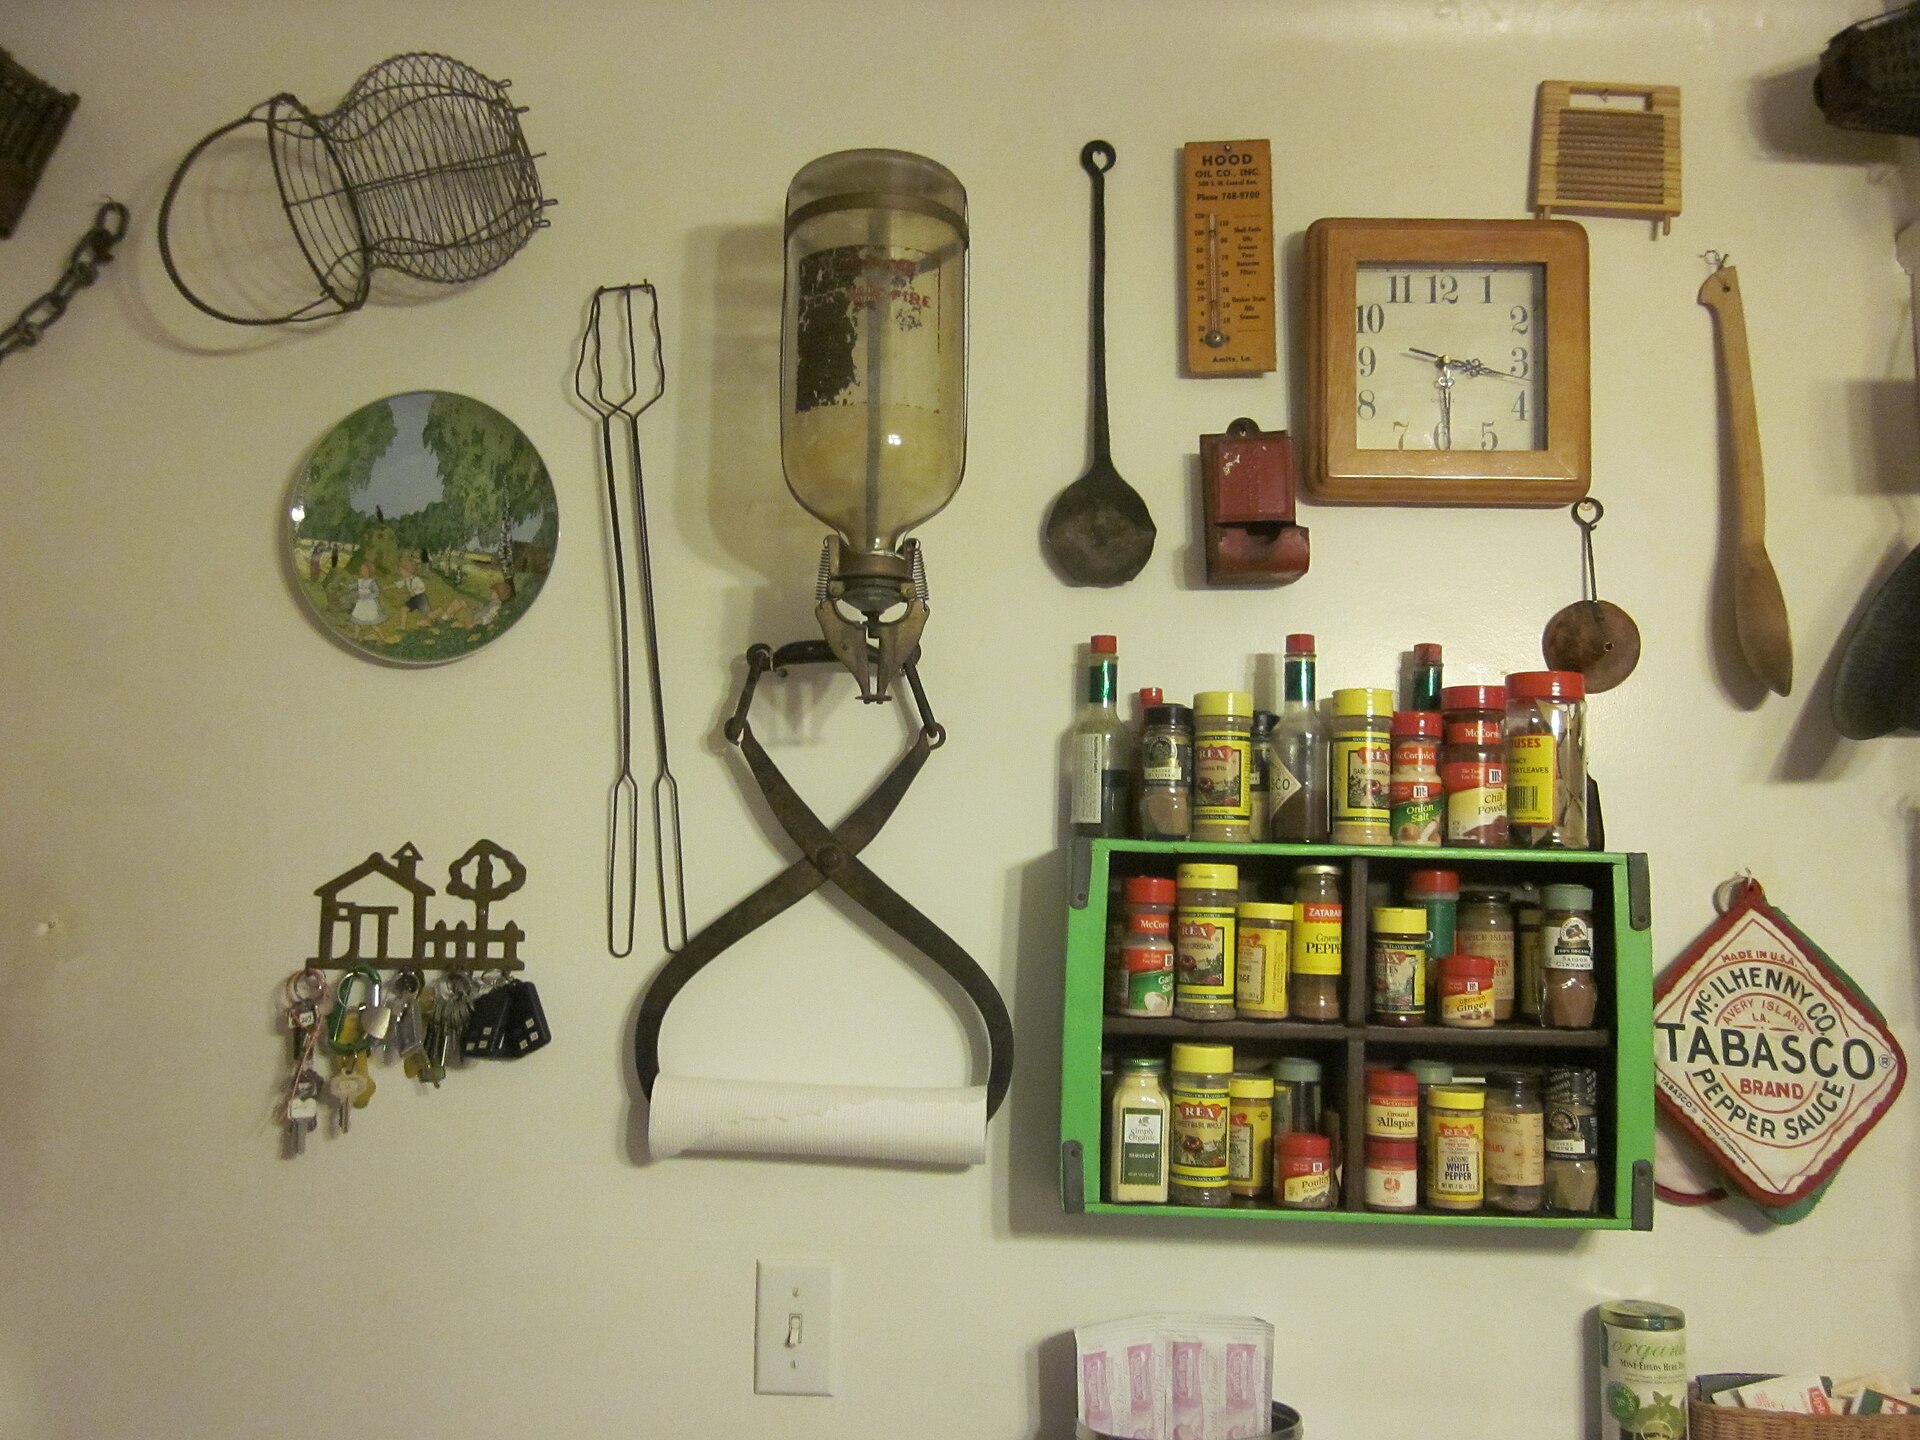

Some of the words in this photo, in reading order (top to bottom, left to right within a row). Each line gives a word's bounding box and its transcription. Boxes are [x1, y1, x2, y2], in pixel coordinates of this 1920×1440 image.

[1195, 170, 1211, 178] OIL
[1202, 154, 1252, 166] HOOD
[1197, 193, 1218, 201] Phone
[1386, 274, 1413, 304] 11
[1424, 275, 1459, 304] 12
[1479, 275, 1493, 304] 1
[1356, 303, 1385, 334] 10
[1510, 305, 1529, 335] 2
[1358, 346, 1376, 377] 9
[1510, 346, 1529, 379] 3
[1357, 389, 1376, 420] 8
[1511, 390, 1529, 421] 4
[1393, 421, 1409, 450] 7
[1433, 421, 1451, 450] 6
[1480, 420, 1499, 451] 5
[1406, 803, 1434, 815] Onion
[1411, 813, 1430, 823] Salt
[1181, 926, 1208, 937] REX
[1721, 951, 1754, 964] MADE
[1756, 949, 1768, 960] IN
[1770, 951, 1798, 967] U.S.A.
[1456, 1002, 1488, 1013] Ginger
[1722, 998, 1755, 1026] AVERY
[1761, 1000, 1805, 1033] ISLAND
[1752, 1012, 1771, 1023] LA.
[1806, 1002, 1836, 1037] CO.
[1655, 1022, 1875, 1081] TABASCO
[1692, 1067, 1776, 1139] PEPPER
[1784, 1080, 1845, 1140] SAUCE
[1740, 1078, 1804, 1101] BRAND
[1185, 1107, 1215, 1118] REX
[1377, 1116, 1416, 1129] Allspice
[1128, 1151, 1156, 1159] mustard
[1446, 1163, 1469, 1172] WHITE
[1444, 1171, 1472, 1181] PEPPER
